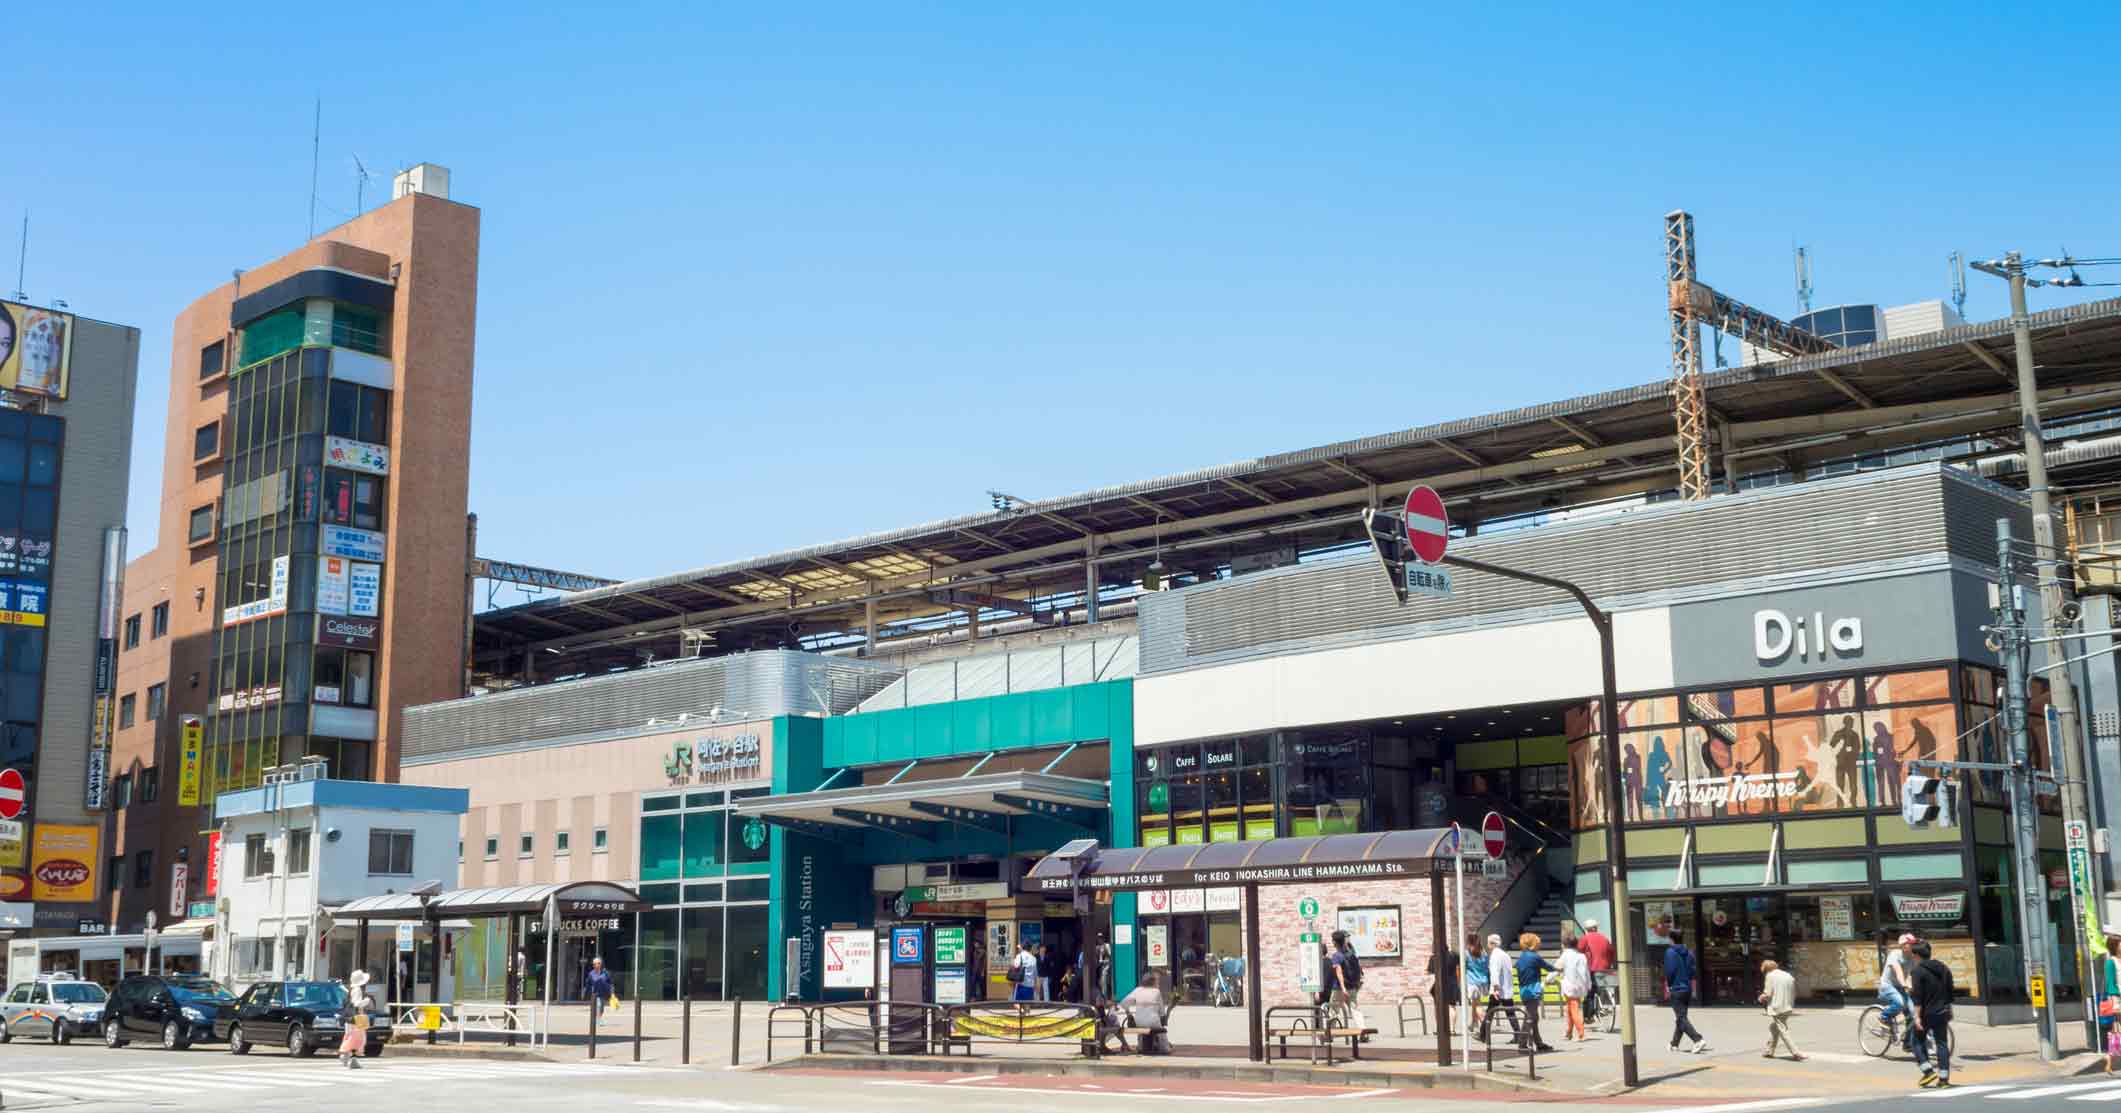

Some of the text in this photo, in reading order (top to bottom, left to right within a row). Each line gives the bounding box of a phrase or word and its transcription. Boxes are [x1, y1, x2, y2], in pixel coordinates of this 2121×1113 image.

[1754, 608, 1863, 662] Dila
[664, 740, 693, 770] JR
[1665, 770, 1799, 807] Krispy Kreme
[1194, 872, 1207, 883] for
[1210, 871, 1230, 881] KEIO
[1236, 869, 1290, 881] INOKASHIRA
[1293, 866, 1313, 877] LINE
[1316, 864, 1383, 876] HAMADAYAMA
[80, 924, 105, 934] BAR
[530, 918, 620, 933] STUCKS COFFEE
[800, 855, 815, 982] Asagaya Station
